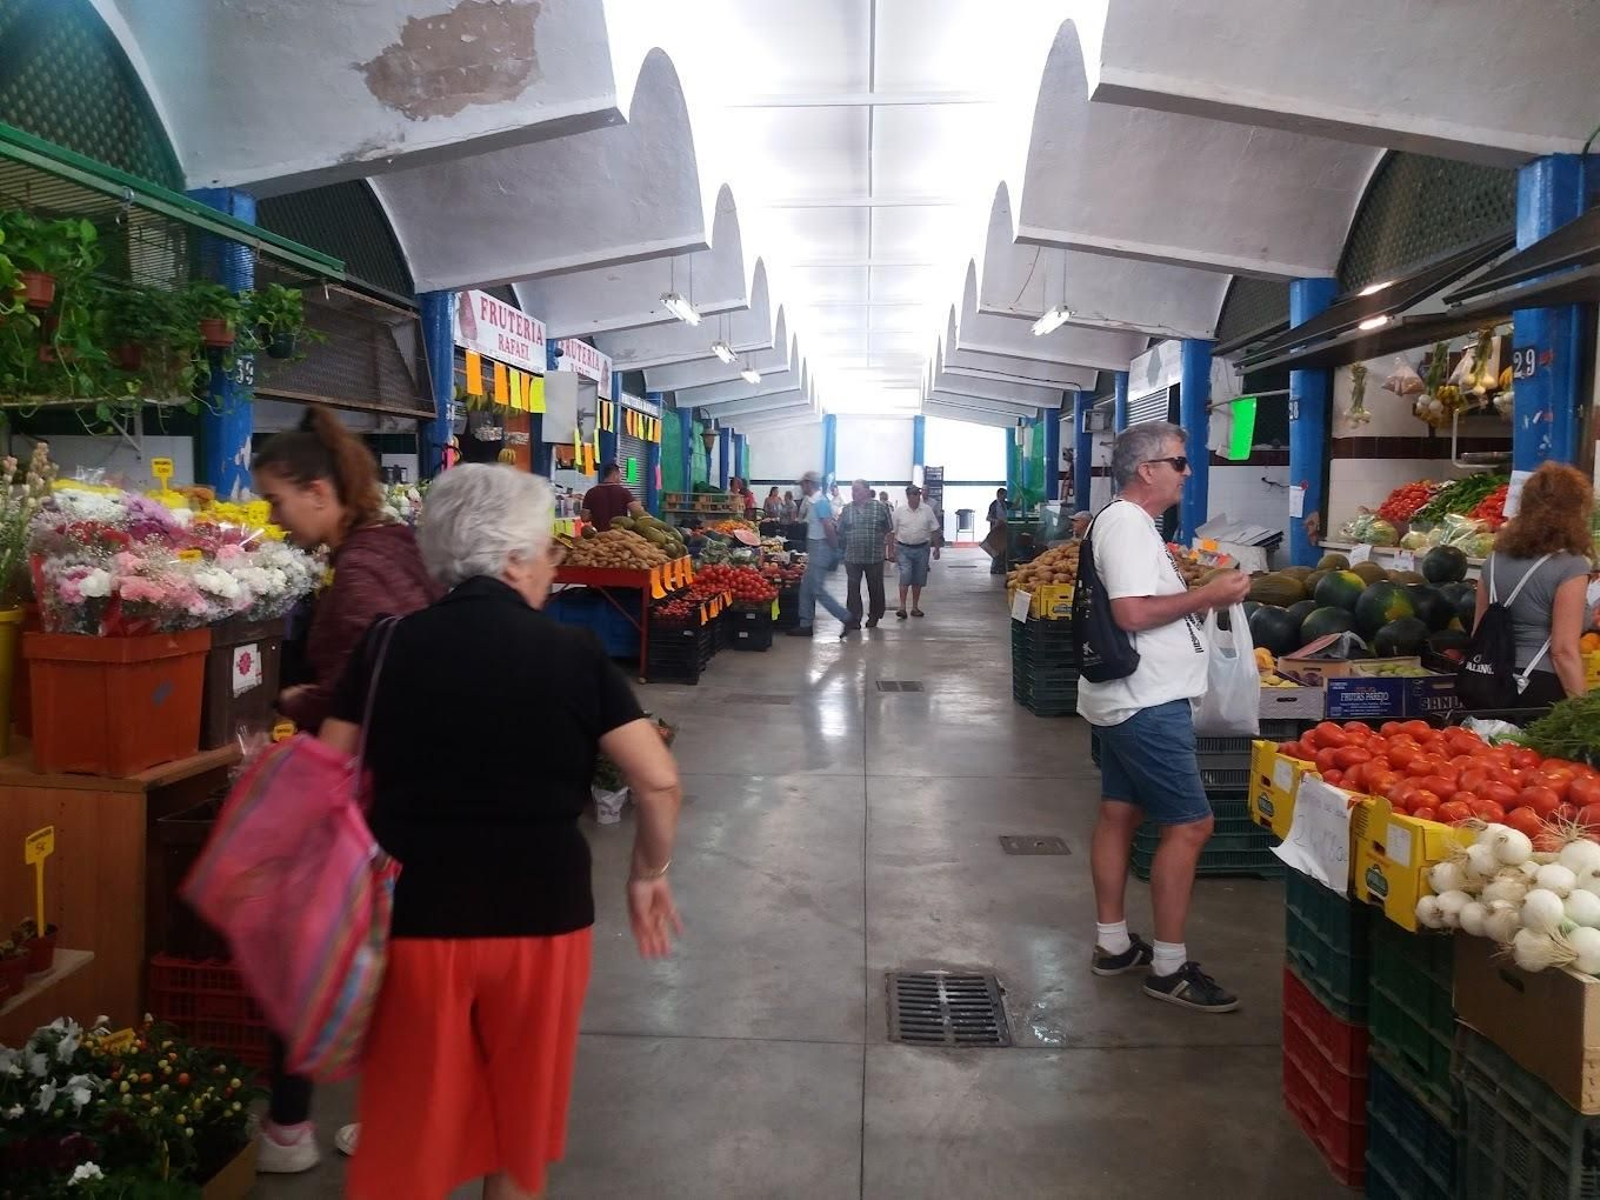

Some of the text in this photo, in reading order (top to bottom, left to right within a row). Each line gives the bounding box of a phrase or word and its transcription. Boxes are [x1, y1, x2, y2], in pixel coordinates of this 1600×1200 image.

[480, 296, 543, 346] FRUTERIA
[498, 333, 530, 361] RAFAEL
[1513, 348, 1535, 379] 29
